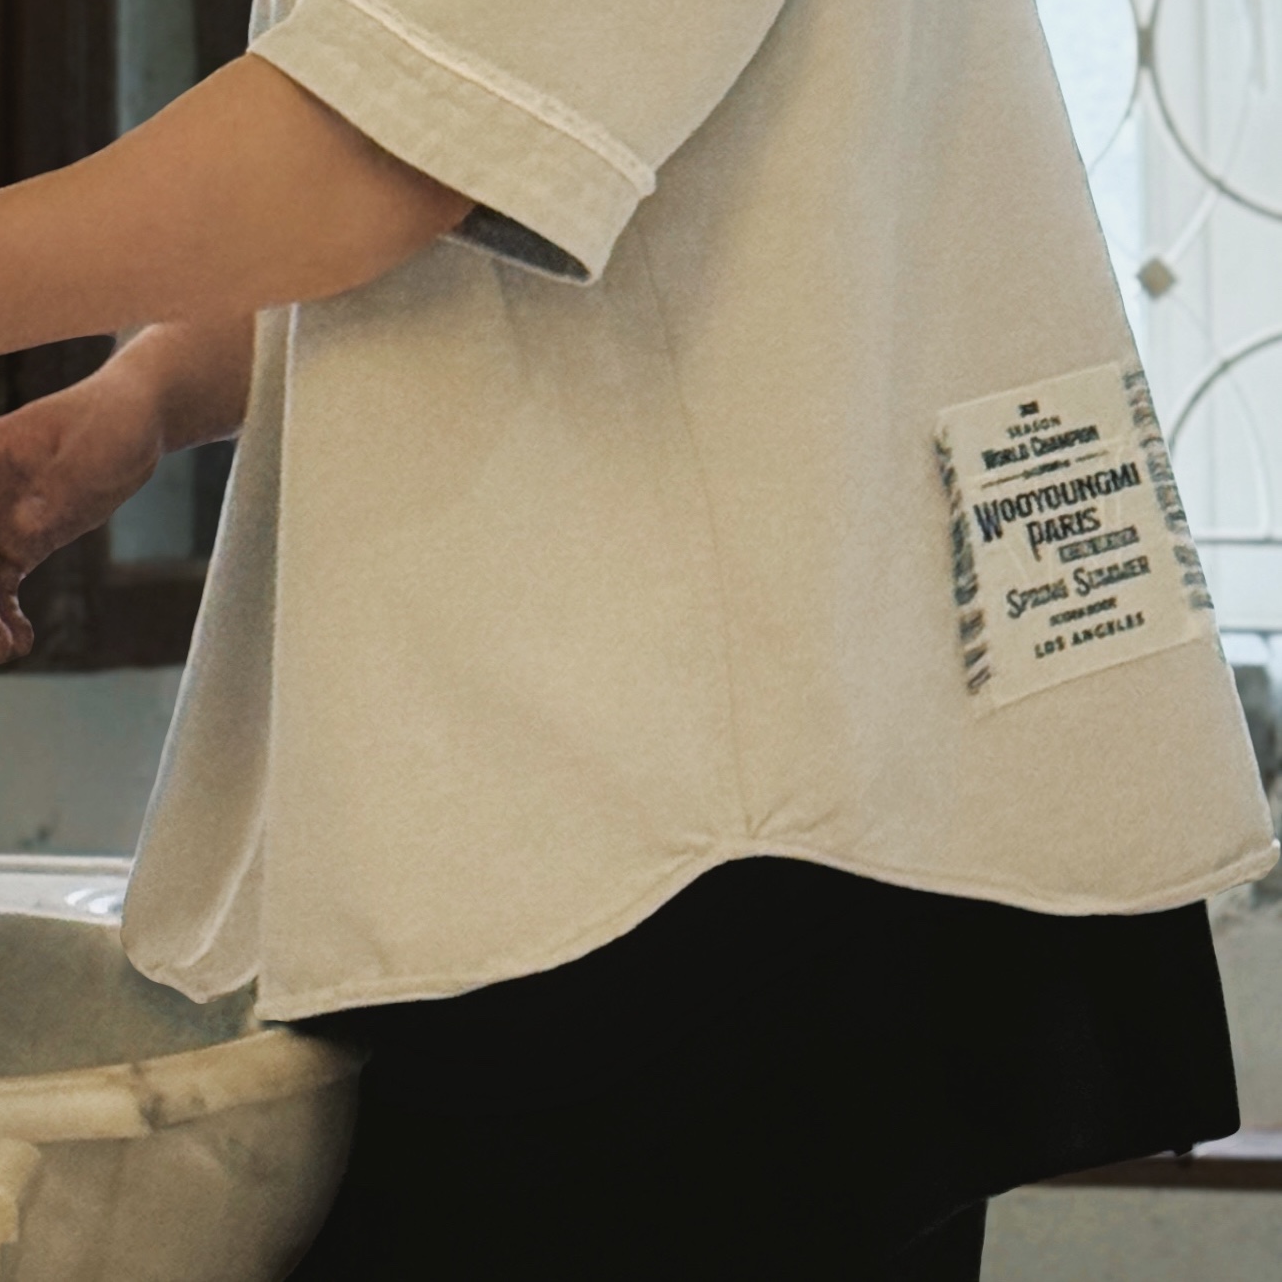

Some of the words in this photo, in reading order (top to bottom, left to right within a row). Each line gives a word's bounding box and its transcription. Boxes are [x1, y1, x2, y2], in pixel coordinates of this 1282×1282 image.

[974, 462, 1142, 543] WOOYOUNGMI
[1026, 506, 1101, 562] PARIS
[1034, 636, 1065, 659] LOS
[1071, 611, 1145, 646] ANGELES
